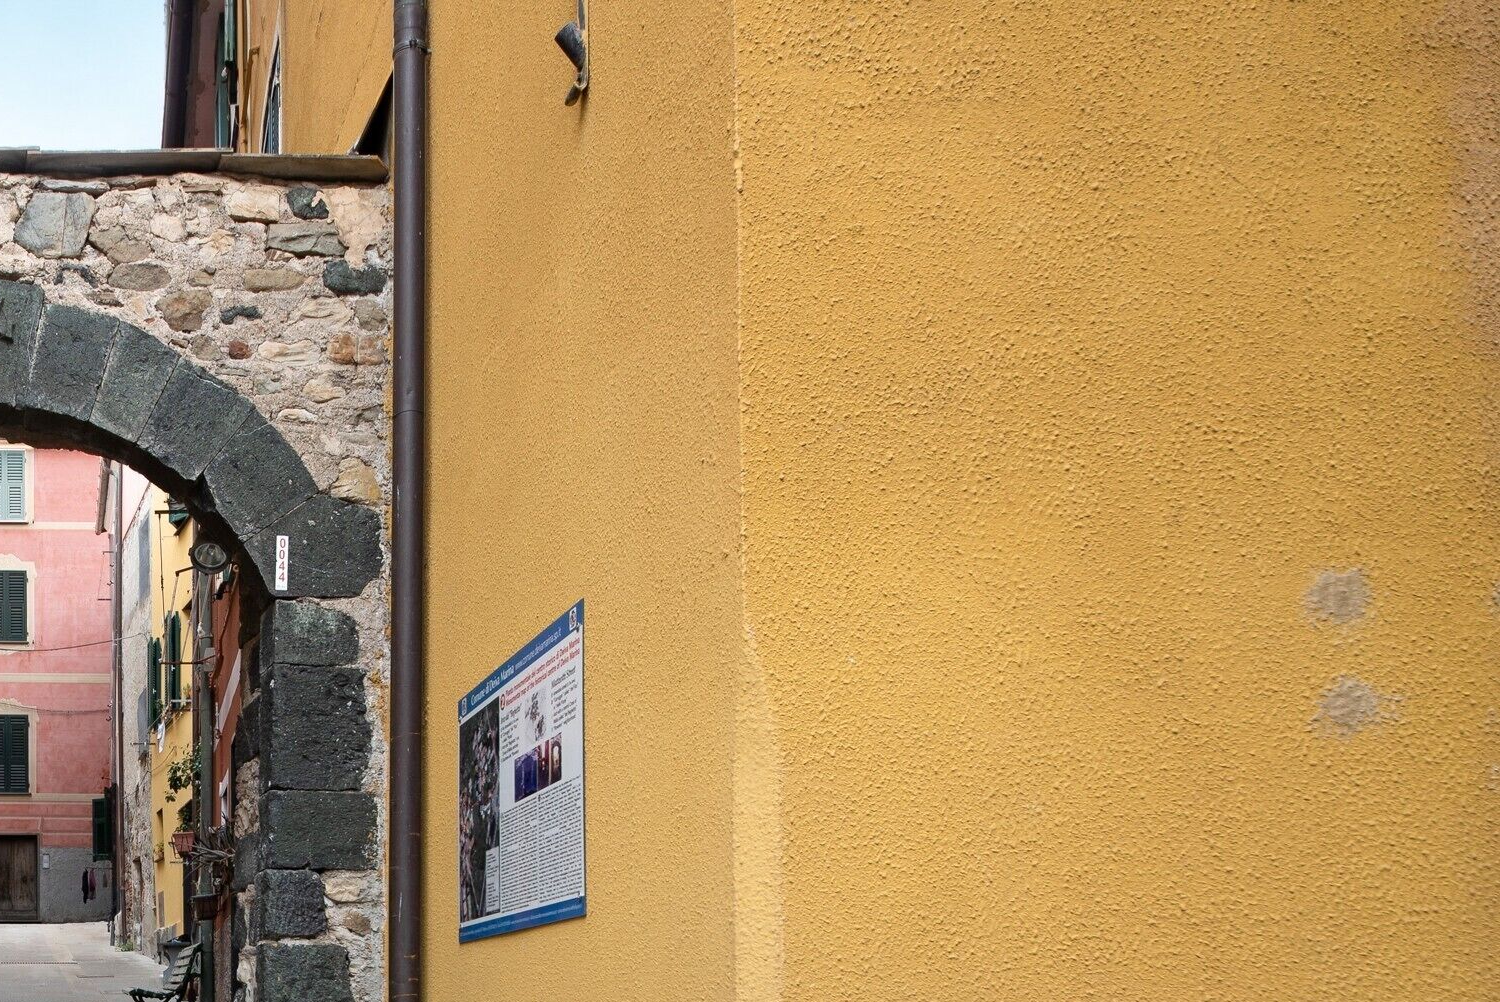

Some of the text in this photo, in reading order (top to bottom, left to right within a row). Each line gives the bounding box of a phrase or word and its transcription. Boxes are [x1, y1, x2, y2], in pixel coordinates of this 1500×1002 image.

[568, 634, 579, 650] Marina
[569, 646, 580, 661] Marina
[470, 686, 484, 707] Comune
[500, 662, 514, 683] Marina
